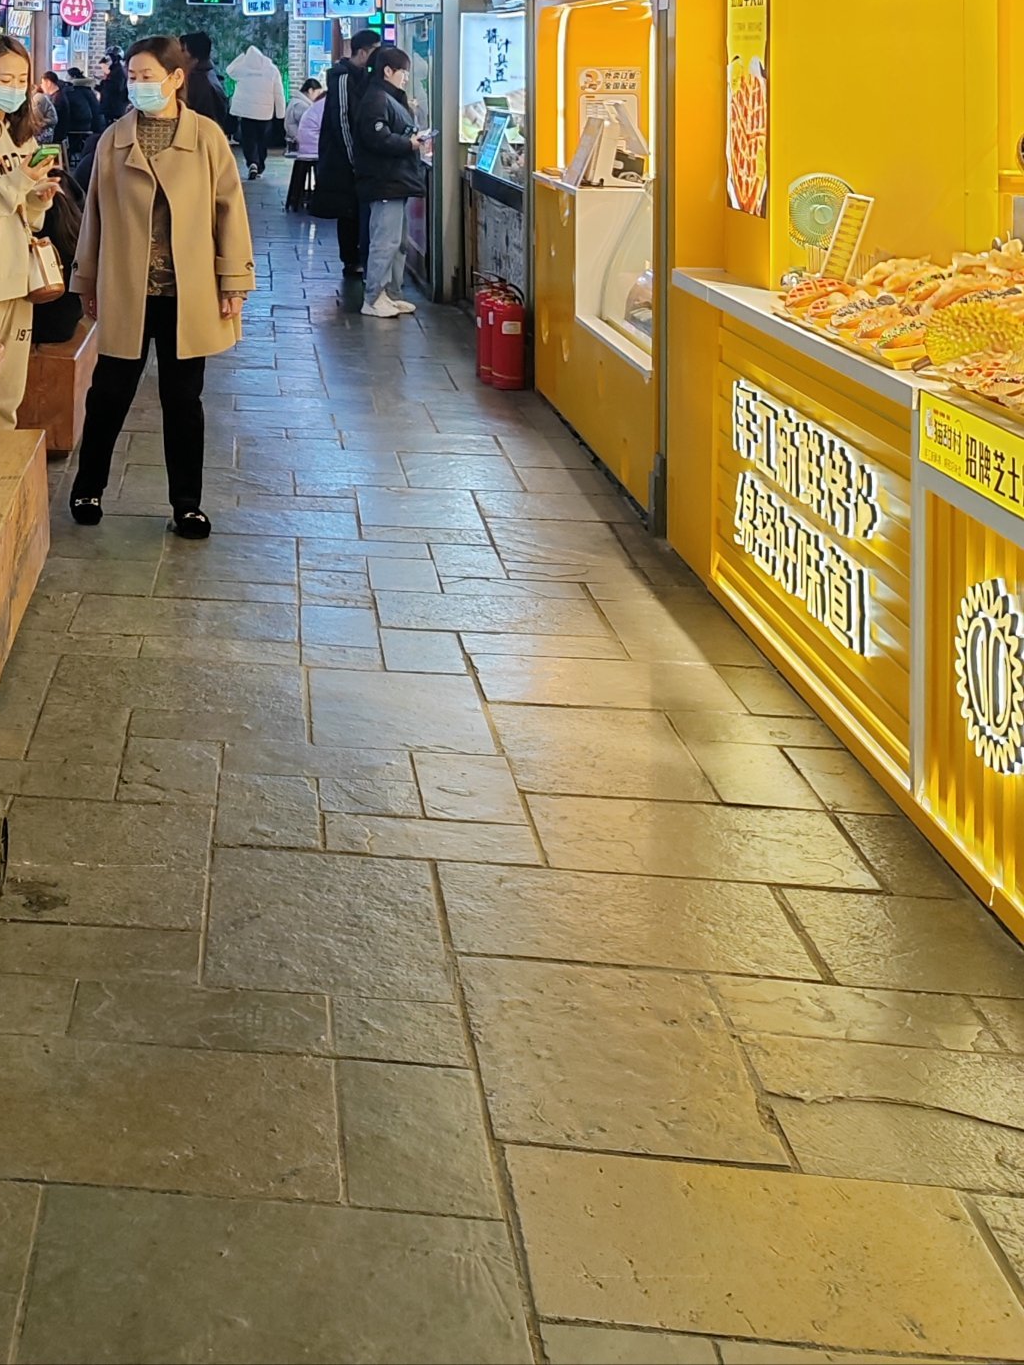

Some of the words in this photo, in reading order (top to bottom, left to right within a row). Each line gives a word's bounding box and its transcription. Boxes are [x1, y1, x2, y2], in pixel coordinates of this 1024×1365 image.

[736, 384, 854, 539] 手工新鲜烤
[965, 433, 1024, 508] 招牌芝士
[734, 472, 854, 650] 绵密好味道
